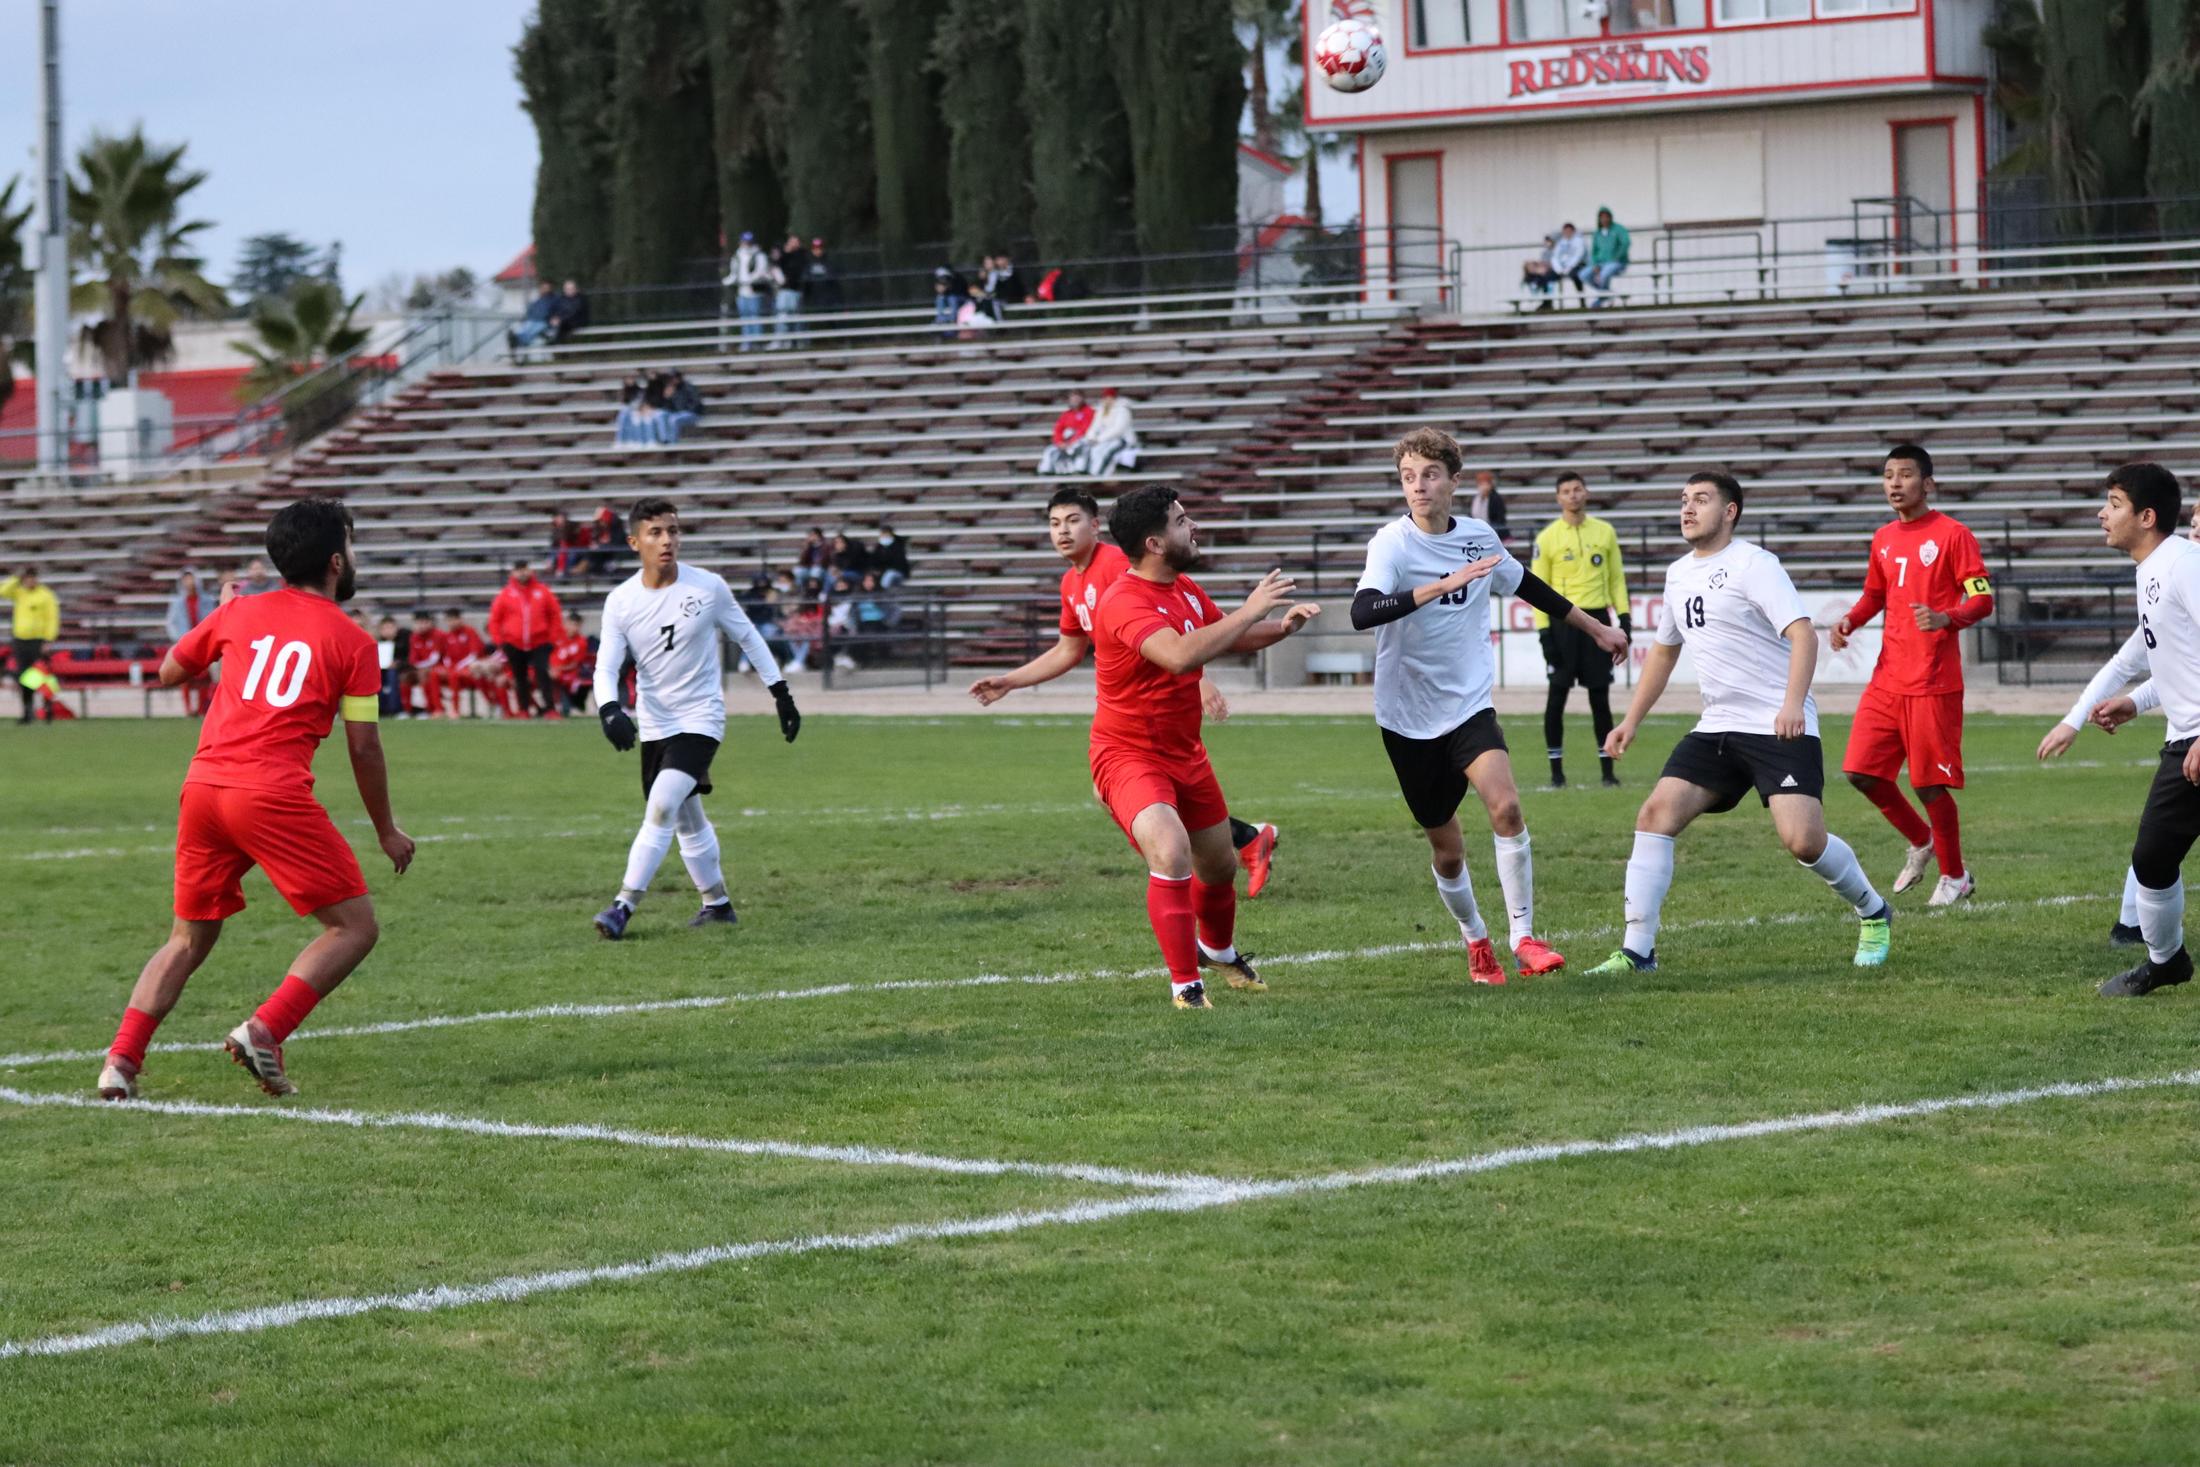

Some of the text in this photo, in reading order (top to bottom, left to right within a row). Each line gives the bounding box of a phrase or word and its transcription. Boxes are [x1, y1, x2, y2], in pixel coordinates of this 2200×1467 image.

[1508, 46, 1710, 97] REDSKINS
[1895, 557, 1908, 588] 7
[1973, 578, 1986, 593] C
[1372, 597, 1399, 610] KIPSTA
[1684, 595, 1706, 629] 19
[660, 624, 675, 652] 7
[241, 634, 312, 708] 10
